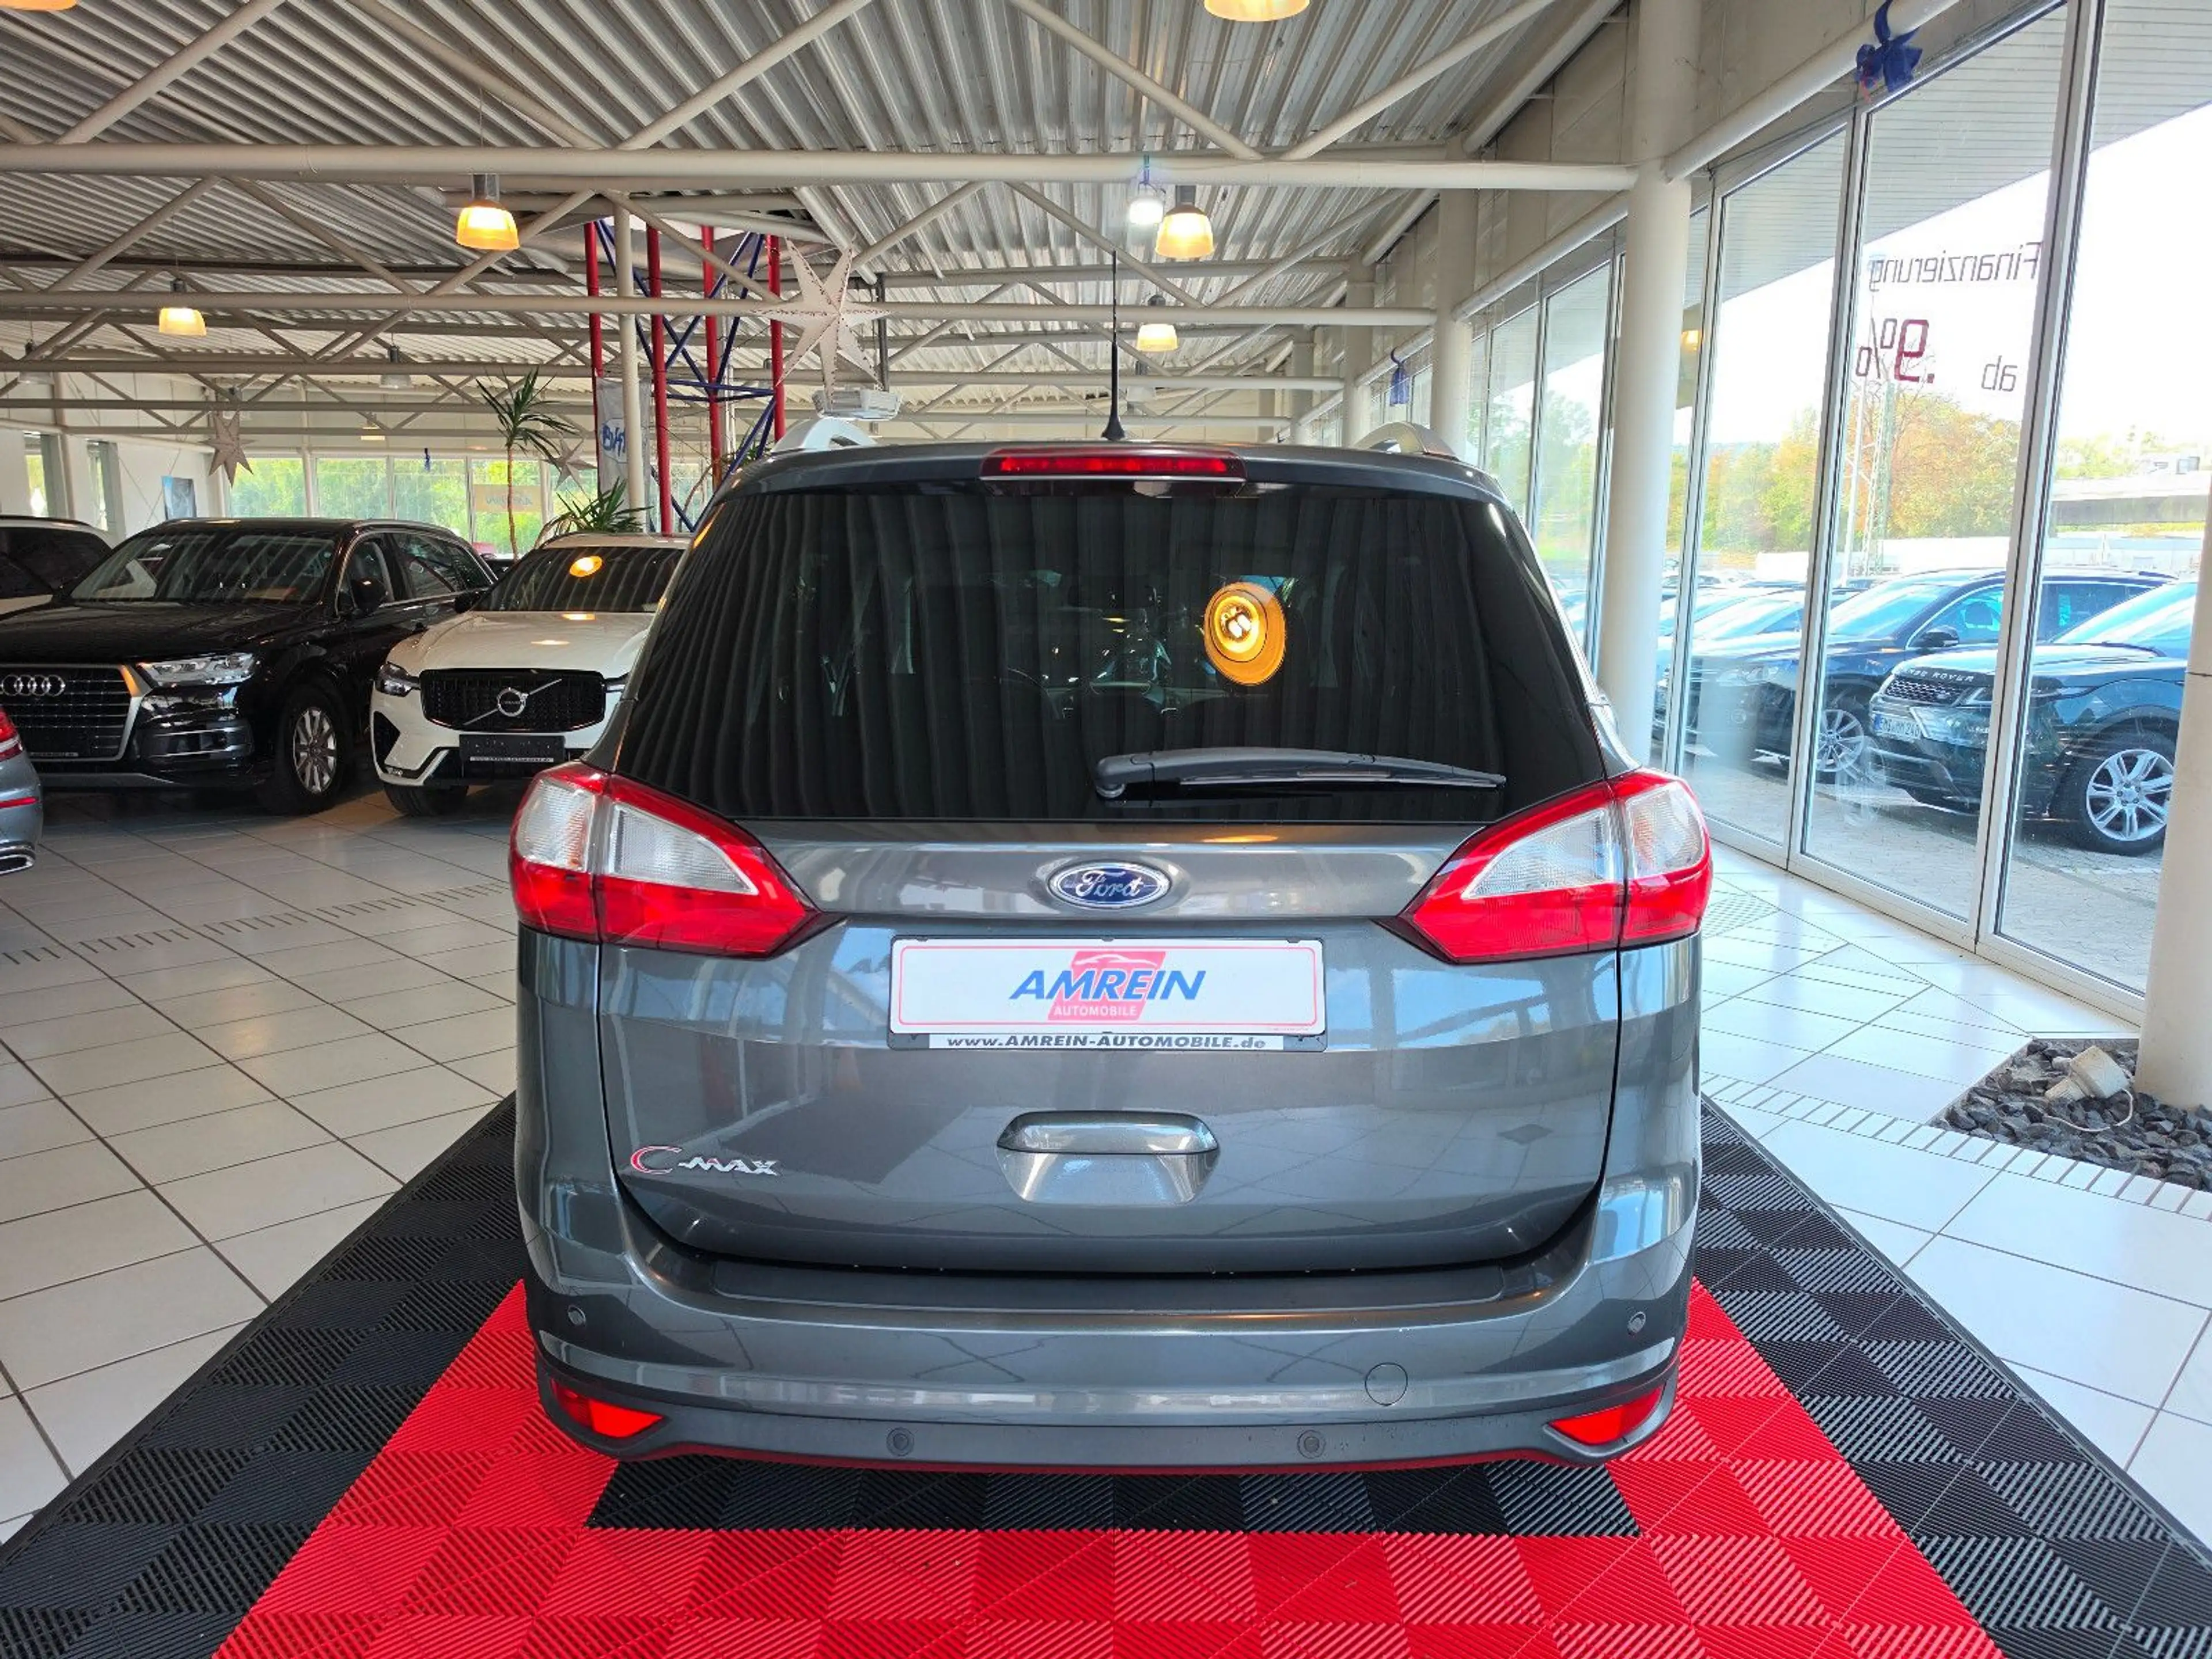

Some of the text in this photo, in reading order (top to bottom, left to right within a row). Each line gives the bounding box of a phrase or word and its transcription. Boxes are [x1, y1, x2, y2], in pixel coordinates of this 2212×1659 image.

[1075, 869, 1145, 897] Ford
[1008, 969, 1207, 1001] AMREIN
[1053, 1005, 1138, 1017] AUTOMOBILE
[946, 1035, 1266, 1050] www.AMREIN-AUTOMOBILE.de
